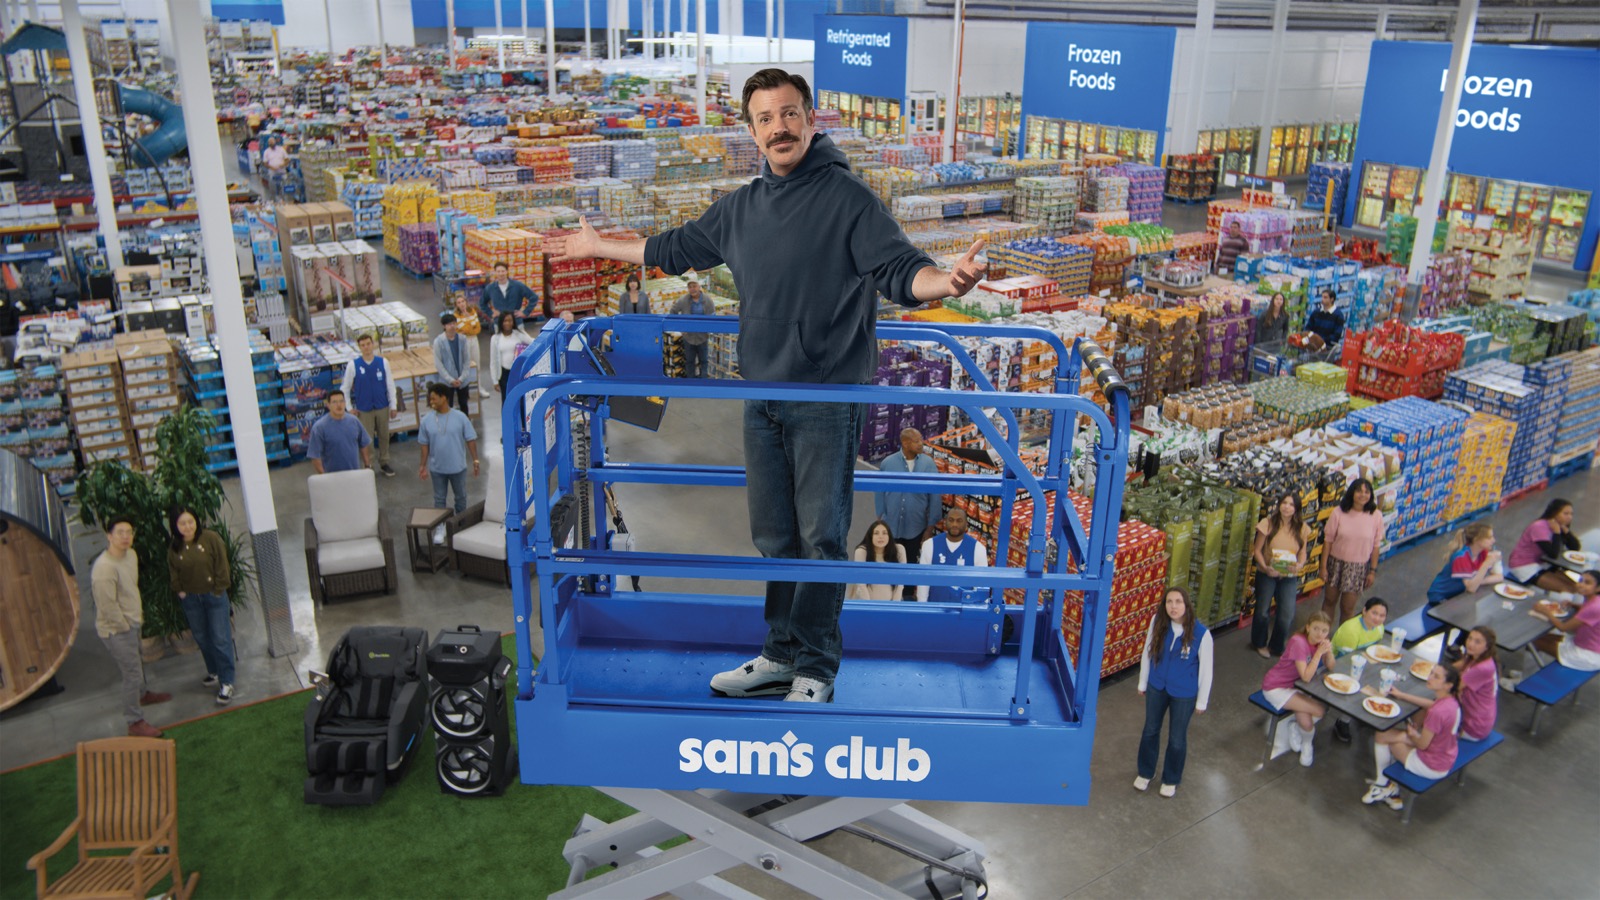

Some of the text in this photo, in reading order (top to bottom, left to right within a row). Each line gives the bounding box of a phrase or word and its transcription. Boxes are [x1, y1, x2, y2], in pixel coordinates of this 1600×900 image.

[827, 28, 891, 48] Refrigerated
[842, 49, 872, 67] Foods
[1068, 43, 1121, 66] Frozen
[1069, 69, 1116, 91] Foods
[1440, 68, 1533, 99] ozen
[1454, 107, 1522, 133] oods
[679, 730, 931, 783] sam's club
